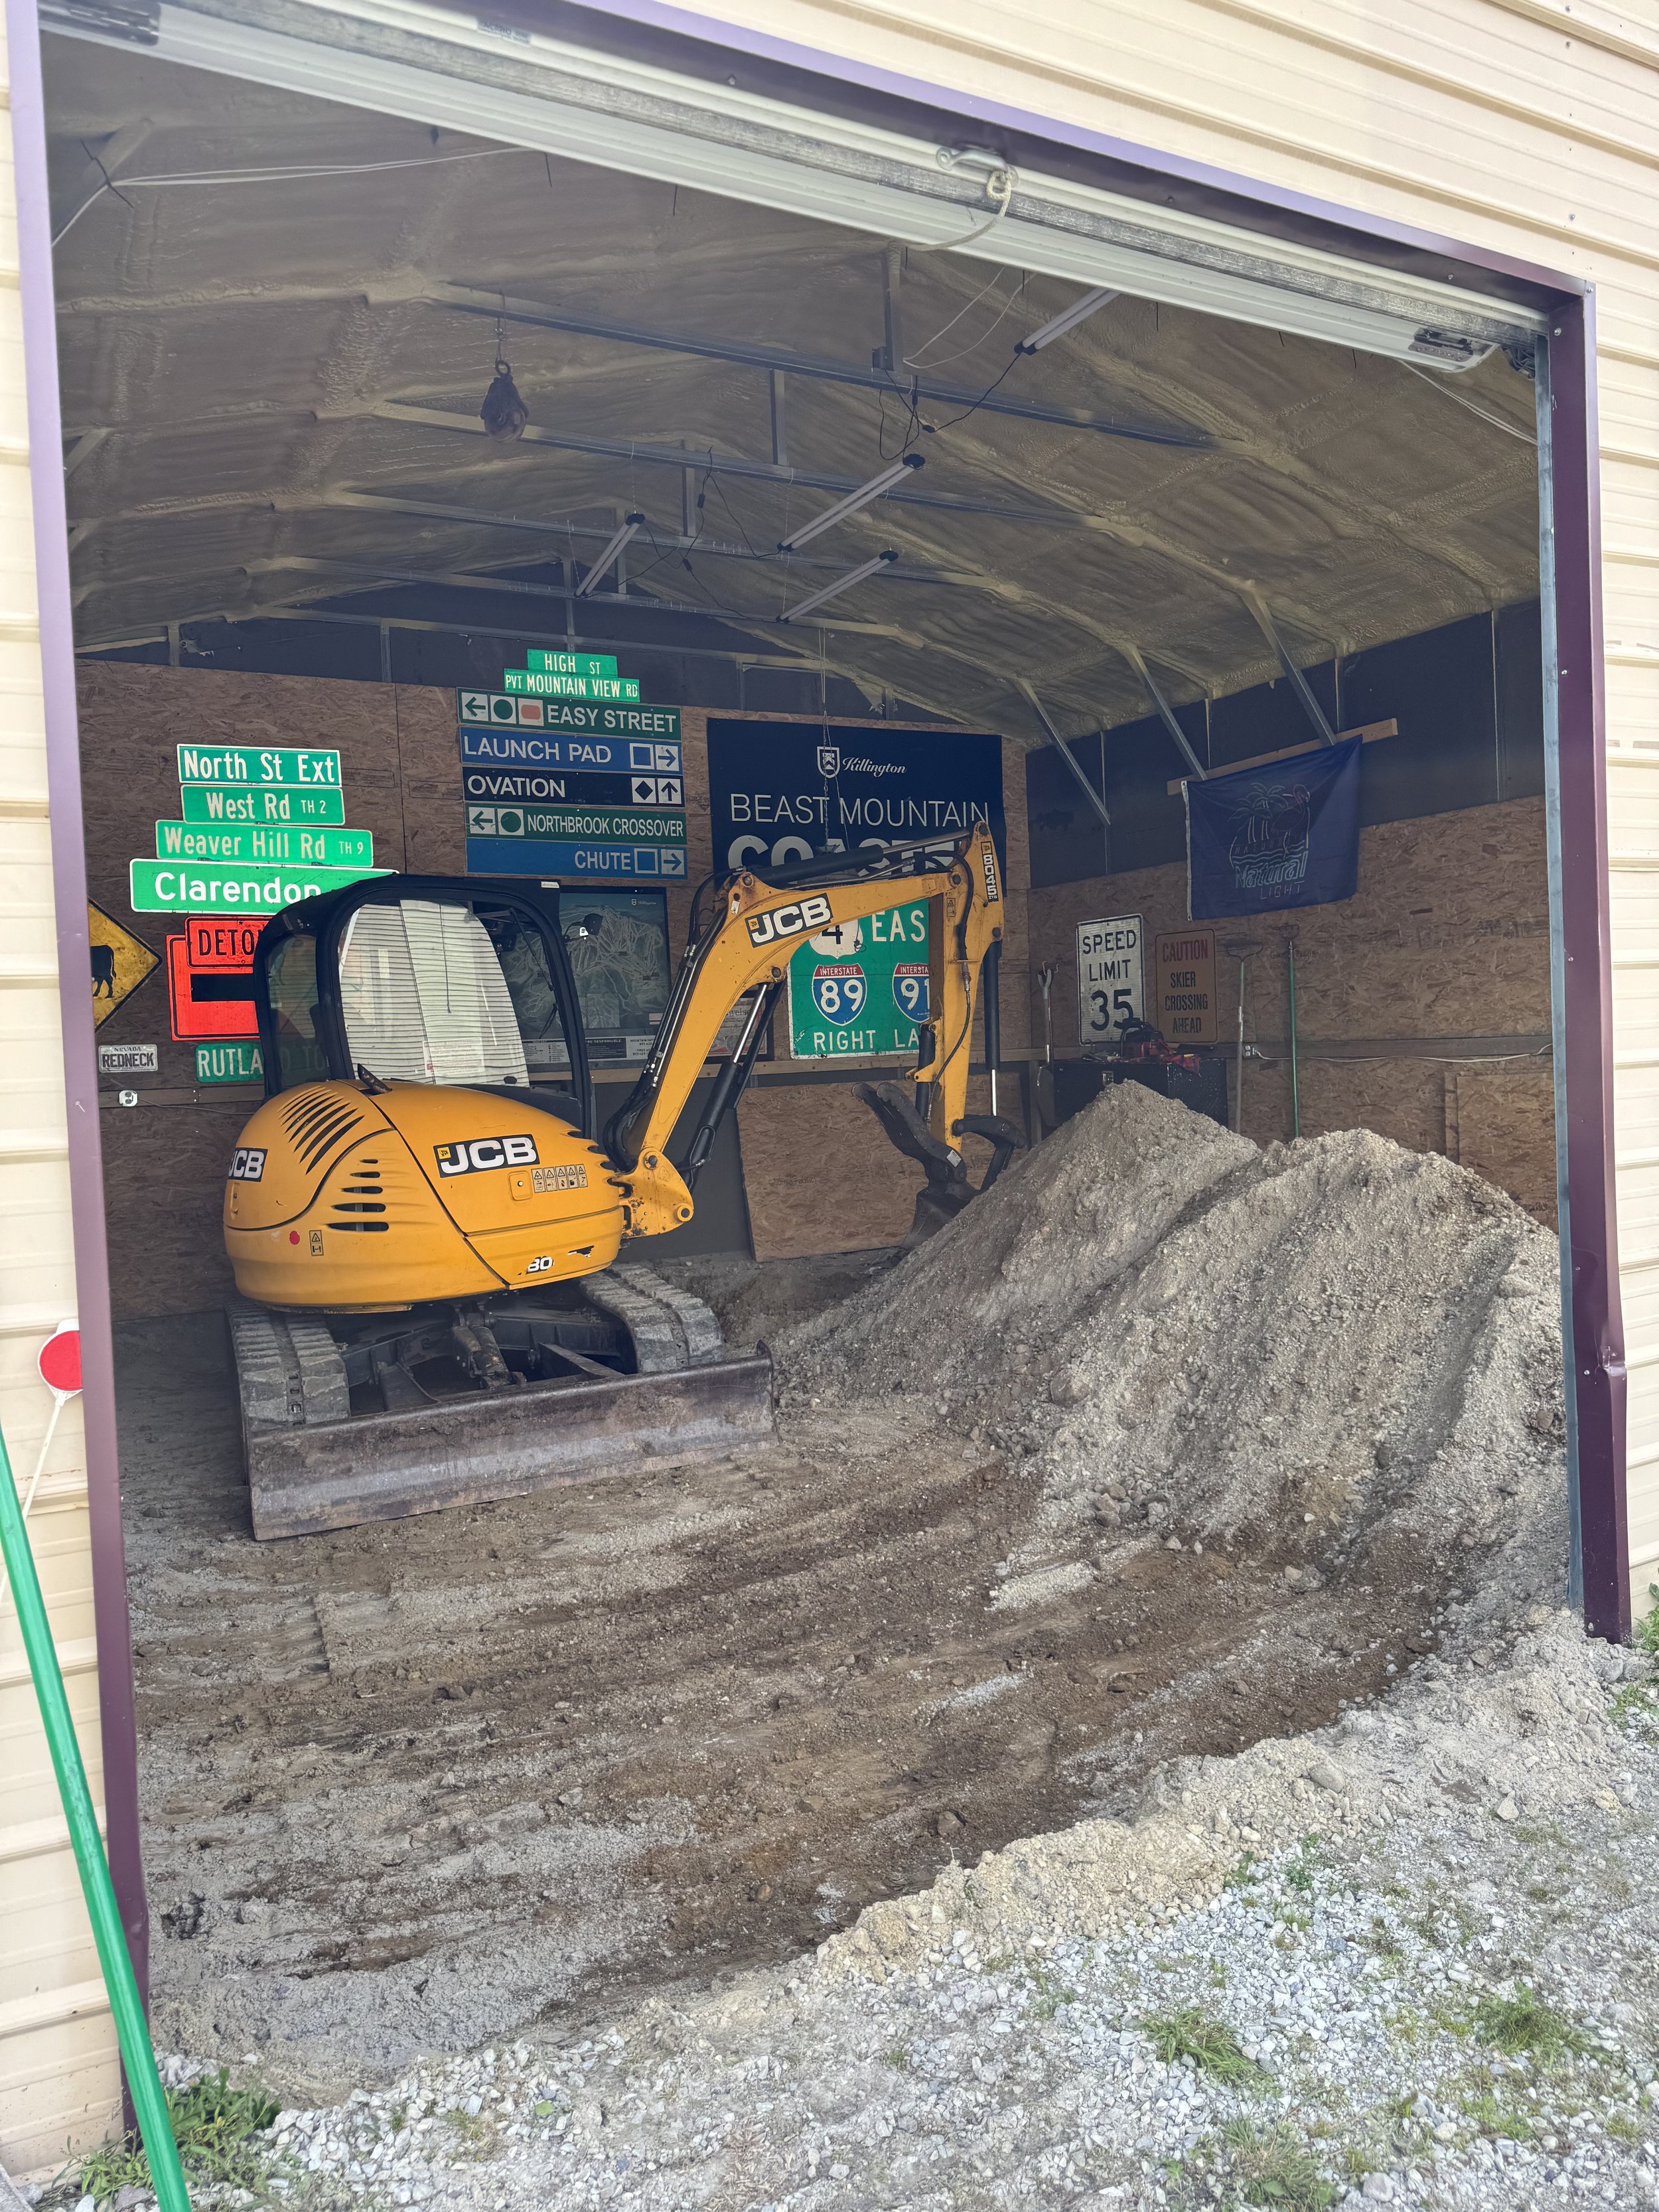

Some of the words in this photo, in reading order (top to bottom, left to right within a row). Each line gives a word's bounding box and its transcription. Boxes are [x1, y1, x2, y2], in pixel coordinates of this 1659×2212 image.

[544, 653, 576, 673] HIGH
[589, 662, 601, 674] ST
[506, 674, 522, 689] PVT
[526, 674, 586, 696] MOUNTAIN
[591, 679, 620, 698] VIEW
[626, 684, 638, 697] RD
[547, 704, 599, 727] EASY
[604, 709, 676, 733] STREET
[464, 735, 560, 761] LAUNCH
[569, 743, 612, 763] PAD
[183, 750, 247, 780] North
[260, 753, 283, 781] St
[297, 754, 335, 782] Ext
[842, 757, 907, 778] Killington
[467, 775, 565, 798] OVATION
[206, 792, 255, 820] West
[264, 793, 291, 820] Rd
[301, 800, 315, 814] TH
[319, 800, 326, 814] 2
[731, 792, 830, 824] BEAST
[839, 797, 989, 828] MOUNTAIN
[528, 814, 611, 836] NORTHBROOK
[613, 818, 684, 838] CROSSOVER
[164, 826, 242, 856] Weaver
[252, 831, 289, 858] Hill
[301, 833, 326, 860] Rd
[338, 841, 352, 855] TH
[356, 841, 364, 855] 9
[574, 850, 631, 871] CHUTE
[1236, 851, 1309, 888] Natural
[155, 871, 321, 904] Clarendon
[983, 854, 997, 895] 8045
[1260, 881, 1305, 899] LIGHT
[751, 897, 831, 943] JCB
[871, 910, 926, 942] EAS
[199, 929, 264, 956] DETO
[1082, 929, 1137, 955] SPEED
[1163, 939, 1208, 962] CAUTION
[820, 967, 857, 976] INTERSTATE
[1089, 959, 1131, 982] LIMIT
[1170, 971, 1196, 989] SKIER
[820, 979, 863, 1013] 89
[1165, 994, 1208, 1011] CROSSING
[1090, 988, 1134, 1031] 35
[1173, 1017, 1202, 1033] AHEAD
[814, 1029, 876, 1051] RIGHT
[102, 1053, 155, 1068] REDNECK
[441, 1137, 537, 1174] JCB
